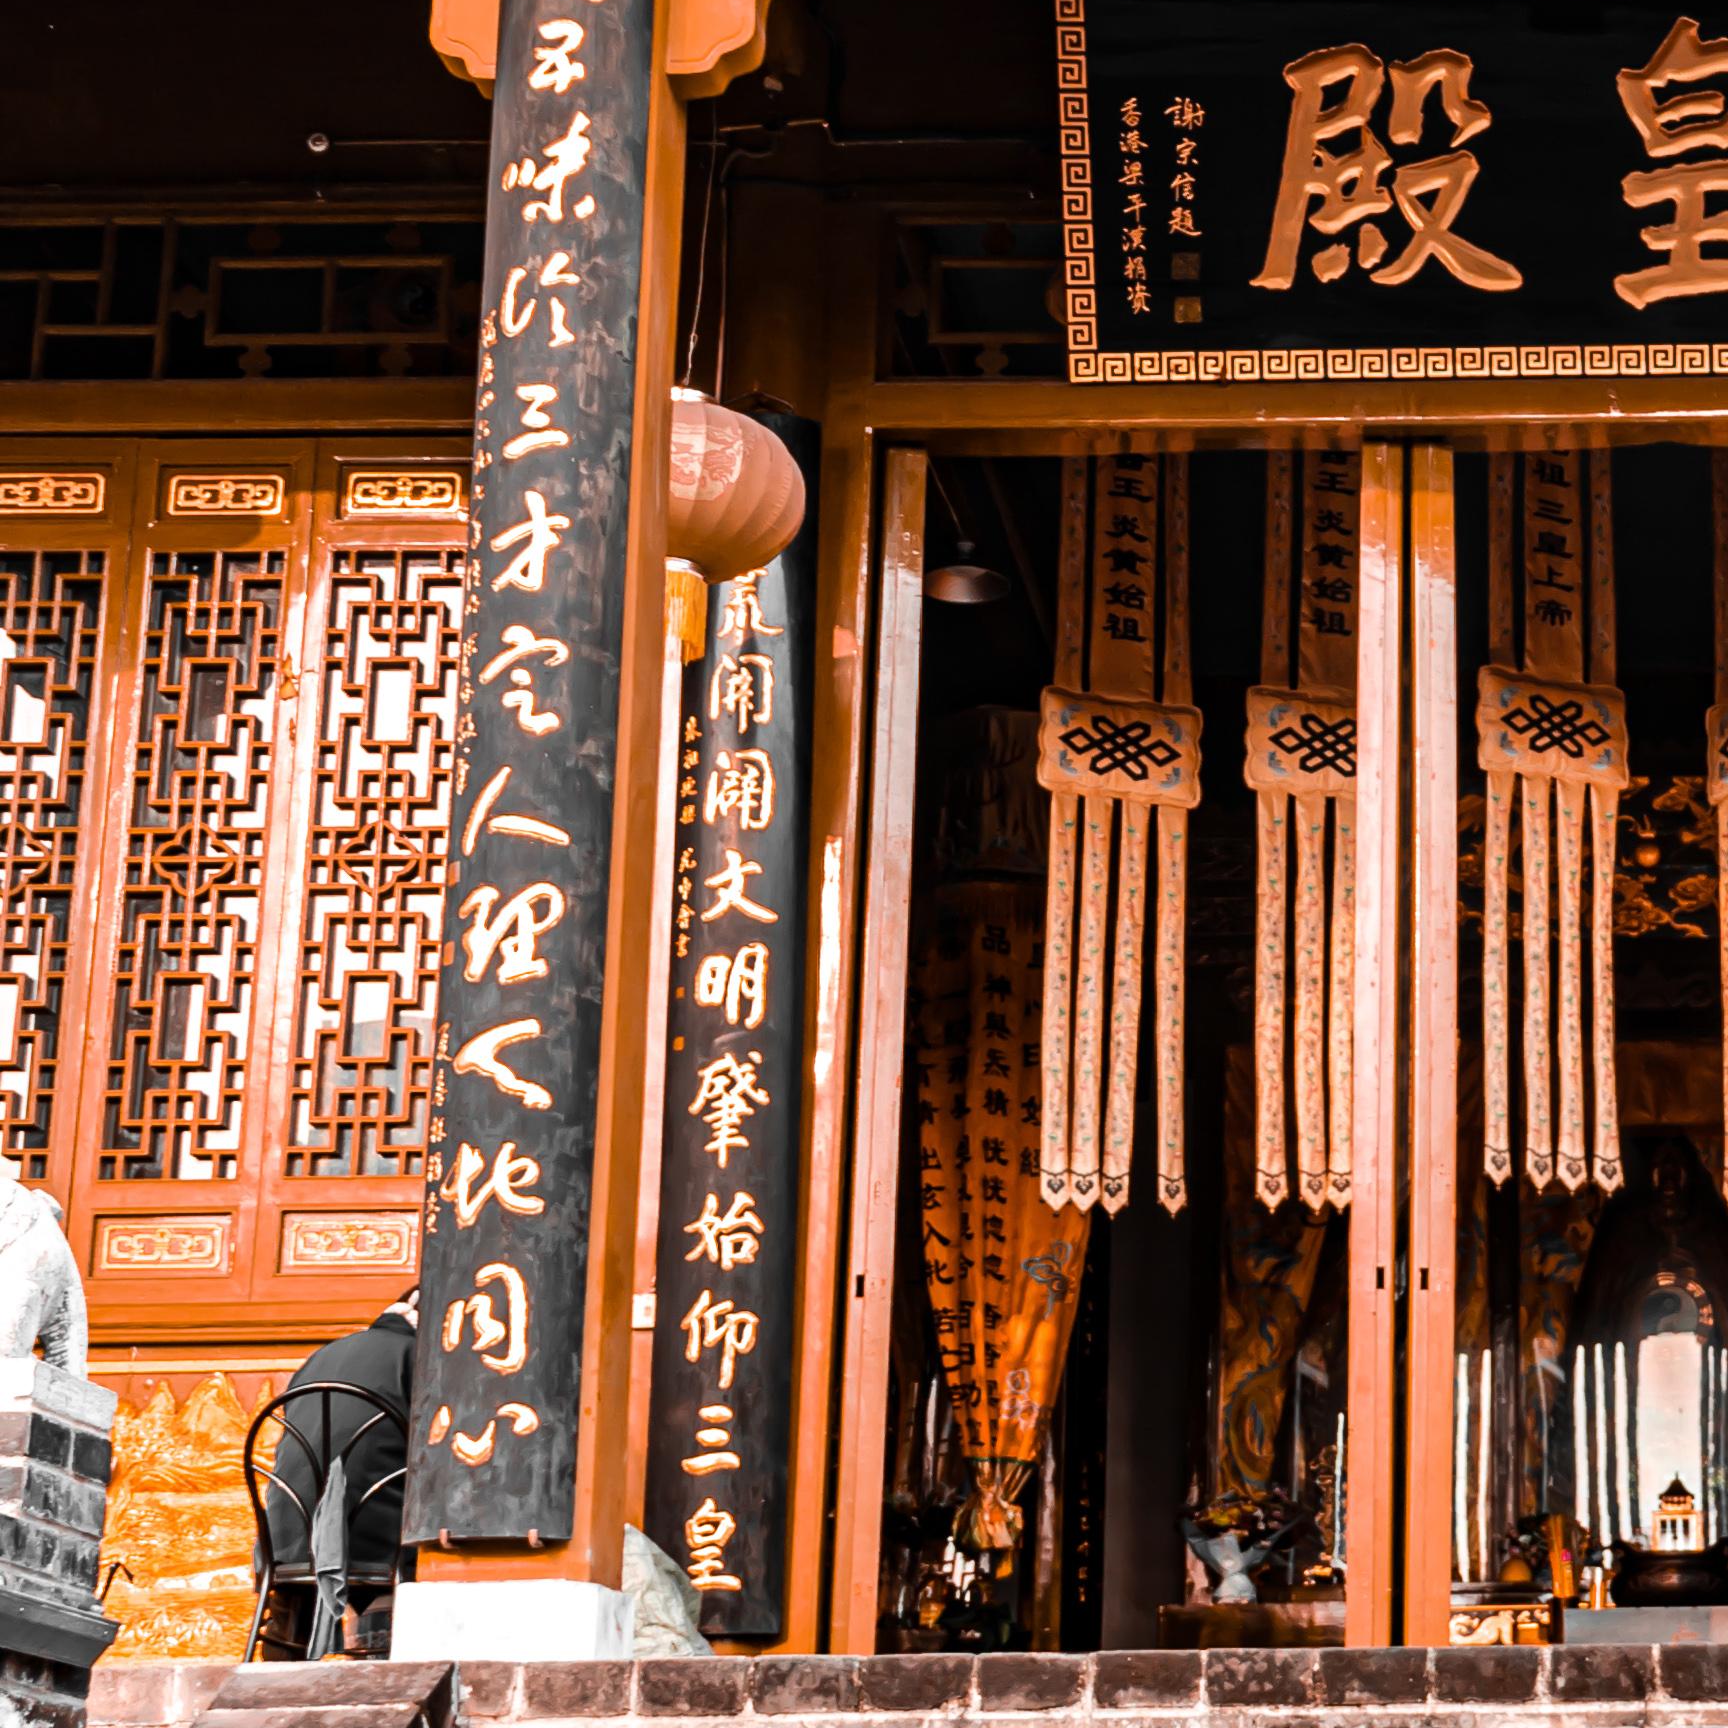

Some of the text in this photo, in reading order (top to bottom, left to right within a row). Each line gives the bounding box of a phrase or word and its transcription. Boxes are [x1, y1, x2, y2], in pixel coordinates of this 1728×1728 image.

[1532, 449, 1575, 627] 祖三皇上帝
